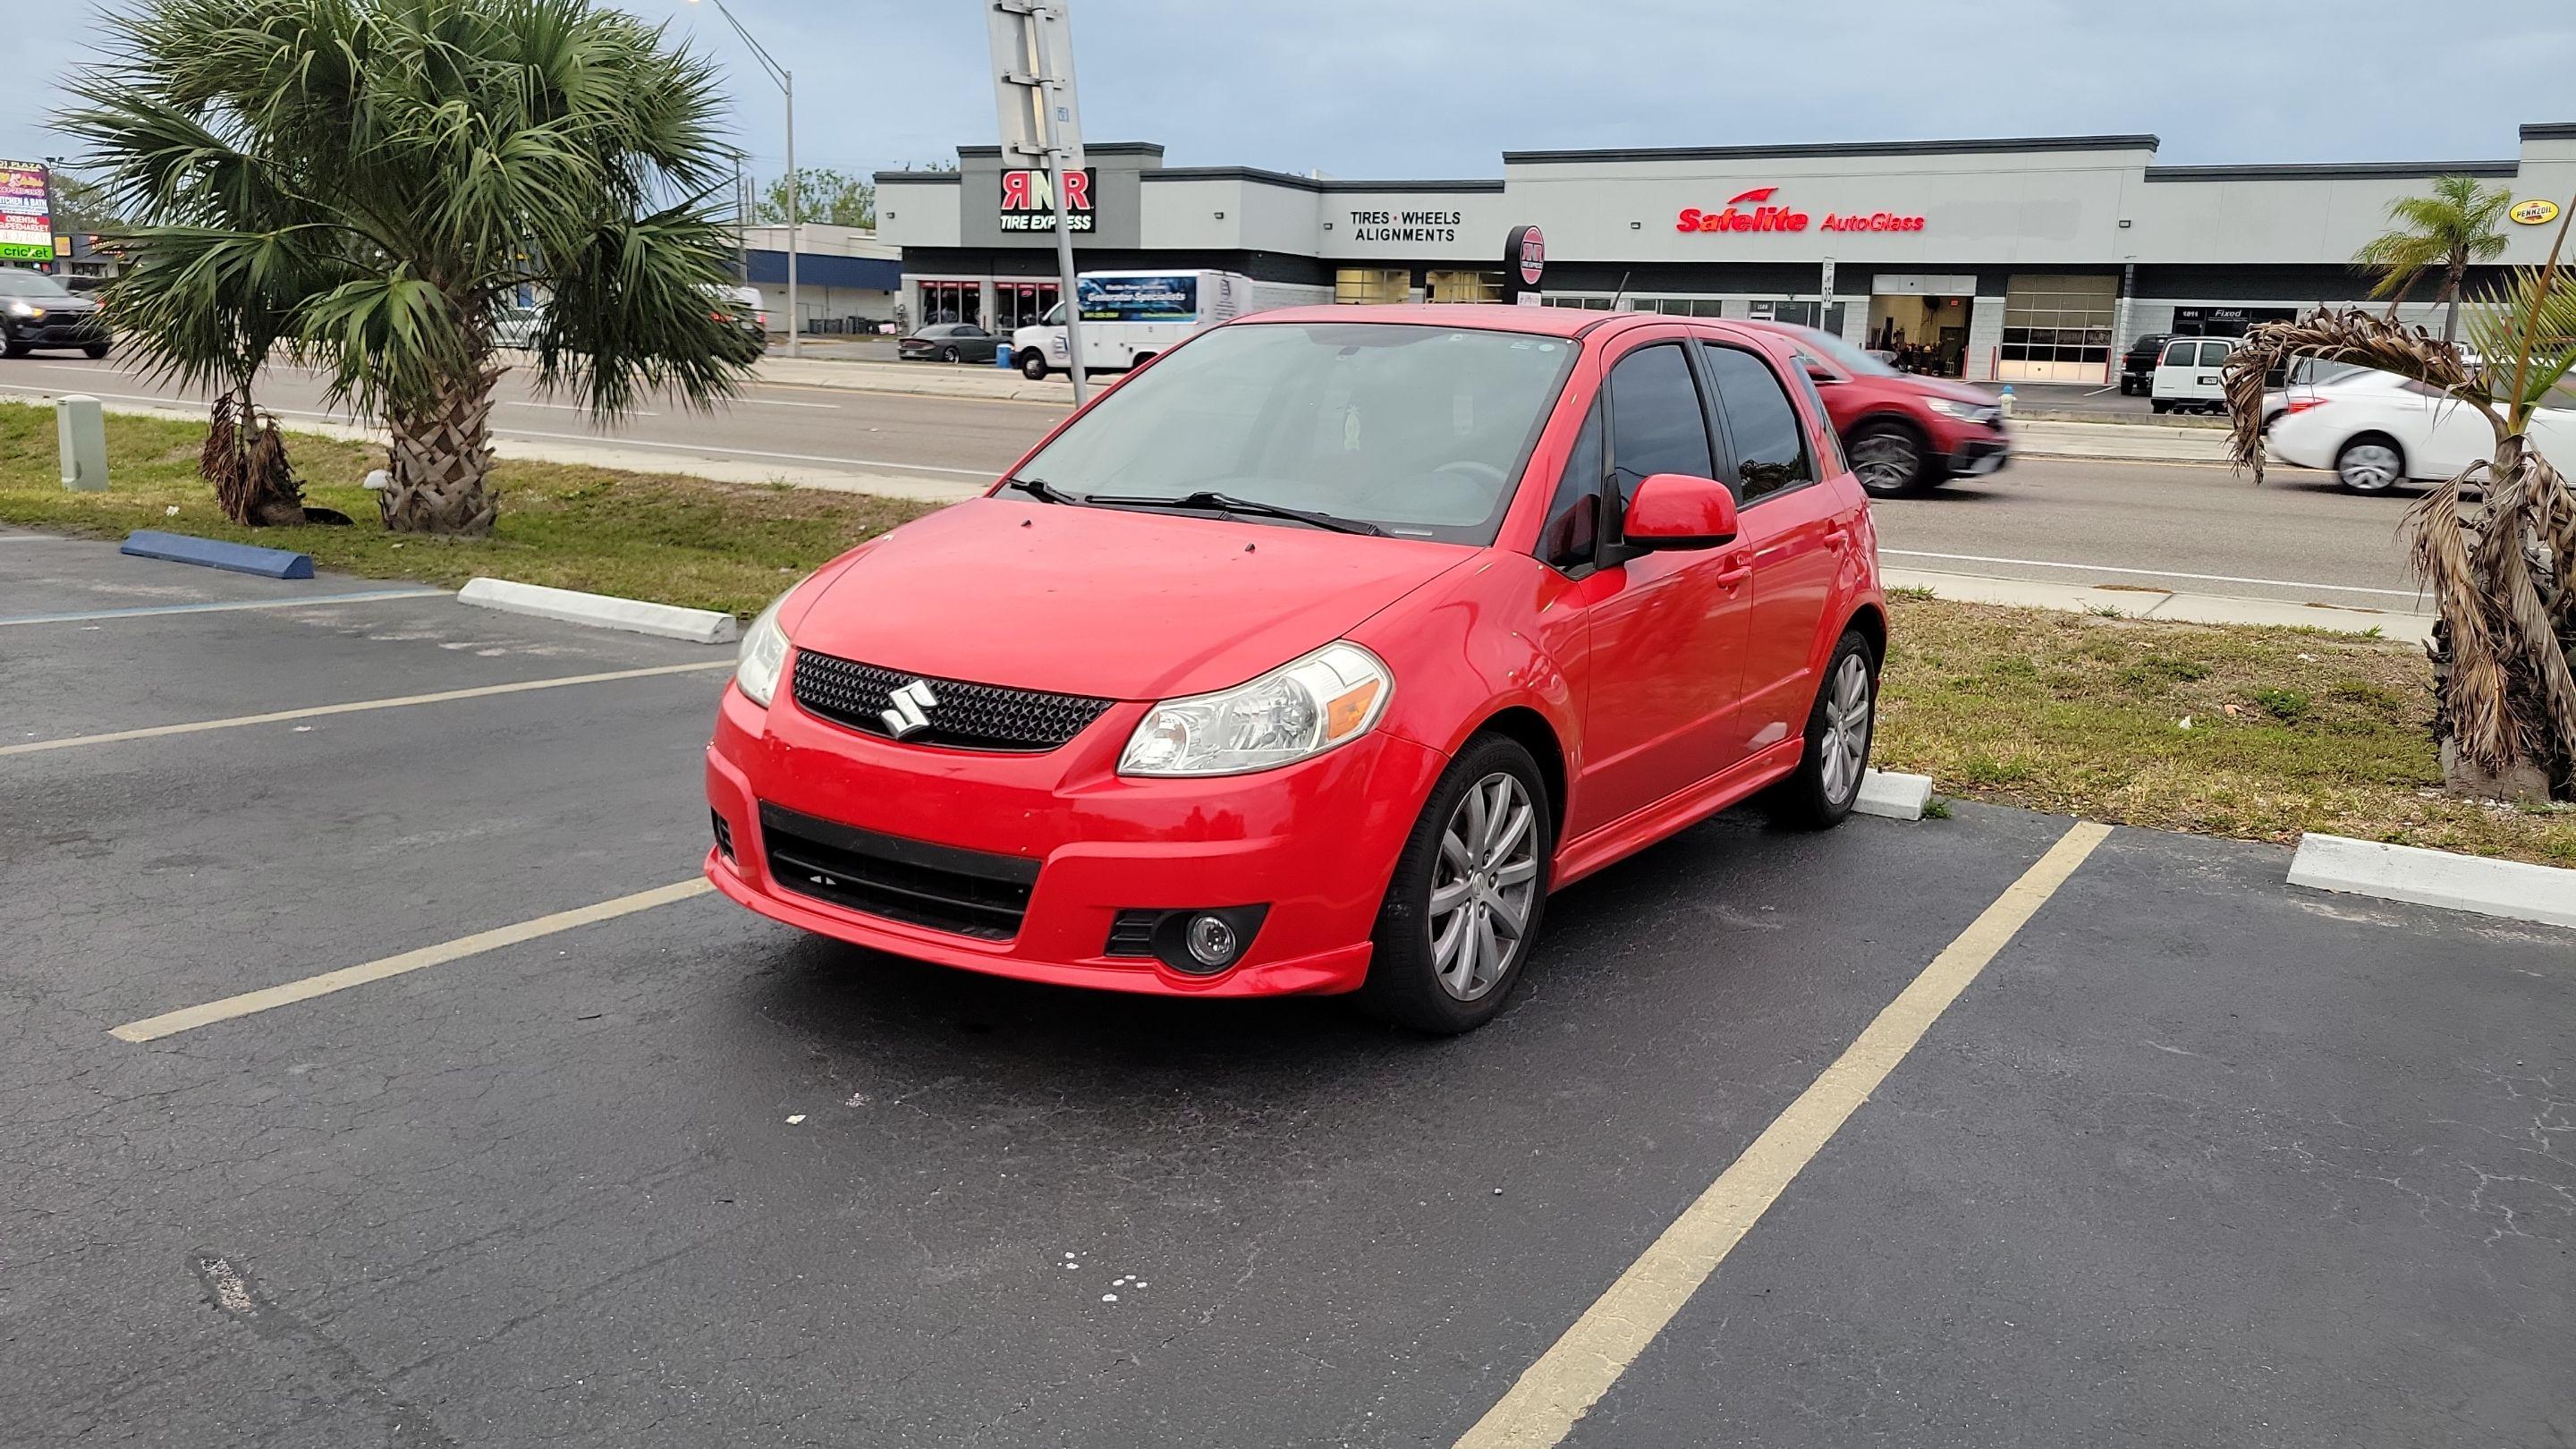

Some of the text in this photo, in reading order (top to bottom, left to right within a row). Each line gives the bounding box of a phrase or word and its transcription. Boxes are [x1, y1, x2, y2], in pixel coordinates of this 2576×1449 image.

[30, 198, 47, 207] BATH
[2516, 206, 2552, 217] PENNZOIL
[5, 215, 39, 225] ORIENTAL
[1000, 215, 1091, 230] TIRE EXPESS
[1351, 211, 1461, 225] TIRES WHEELS
[1676, 206, 1926, 232] Safelite AutoGlass
[1355, 228, 1455, 242] ALIGNMENTS
[4, 246, 48, 258] cricket
[1133, 292, 1187, 303] Specialists
[2215, 309, 2242, 318] Fixed
